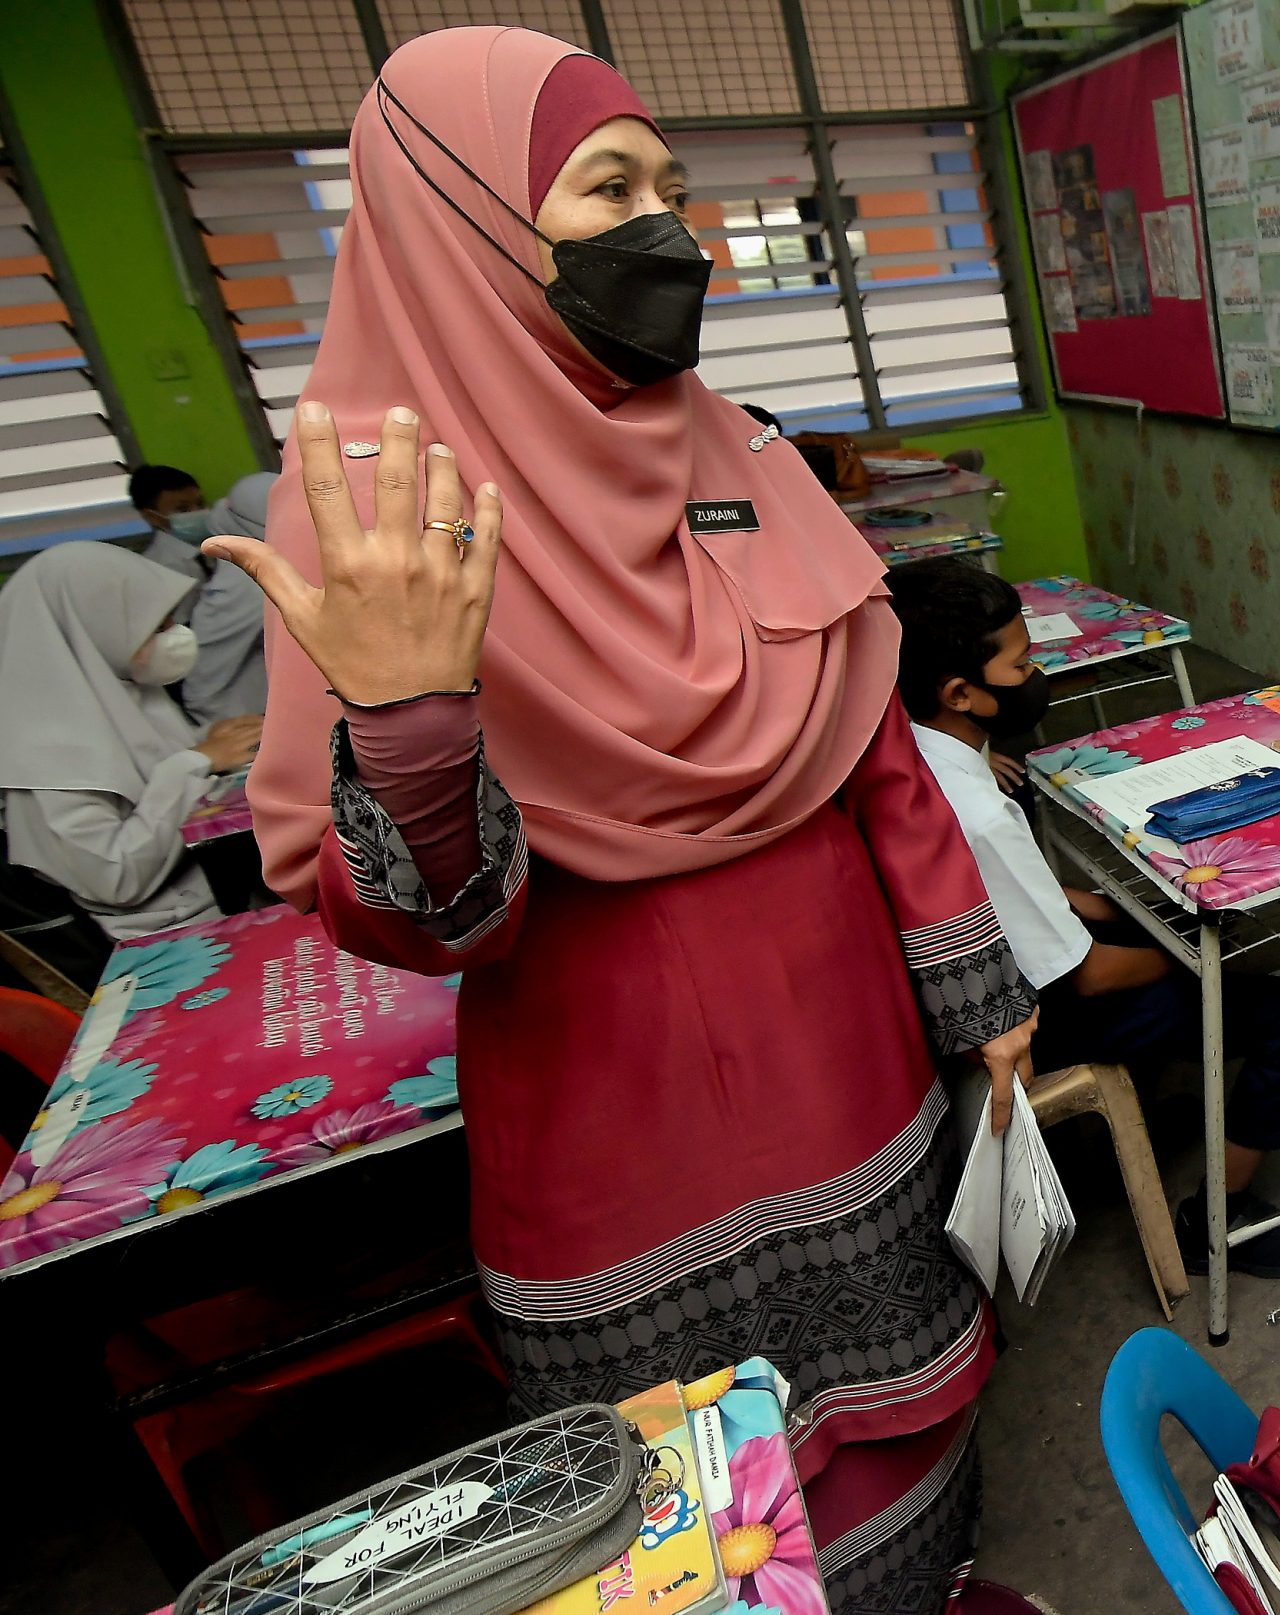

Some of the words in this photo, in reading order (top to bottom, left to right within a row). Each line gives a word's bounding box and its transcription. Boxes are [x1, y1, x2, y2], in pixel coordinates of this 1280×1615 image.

[694, 509, 741, 522] ZURAINI
[256, 1010, 300, 1047] hidup
[299, 1017, 332, 1057] kunci
[332, 1009, 365, 1039] guru
[703, 1410, 711, 1427] NUR
[385, 1487, 465, 1534] FLYING
[400, 1504, 464, 1540] IDEAL
[344, 1540, 386, 1568] FOR
